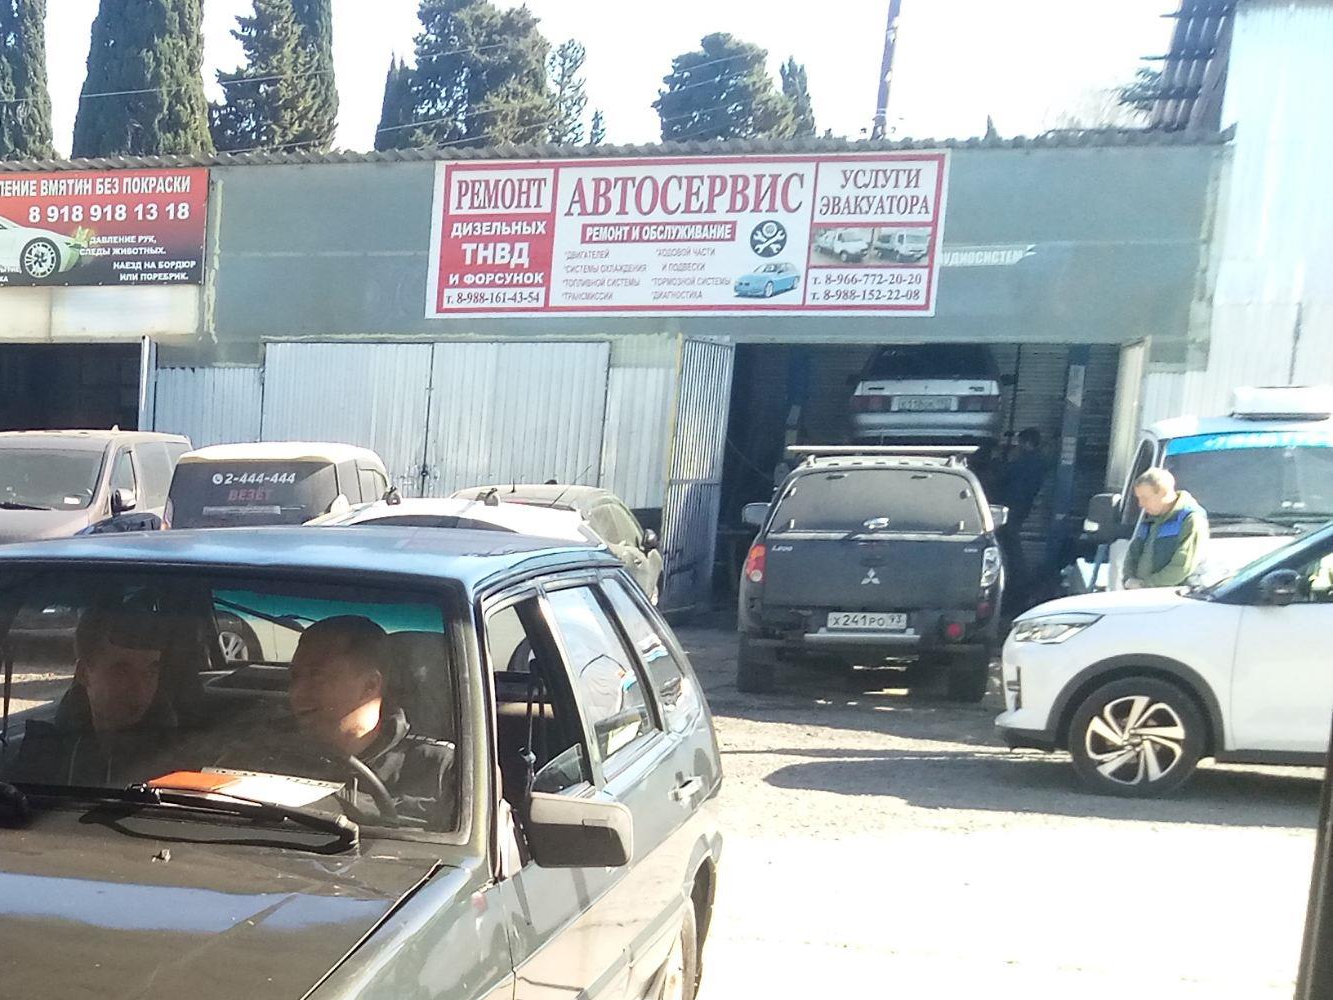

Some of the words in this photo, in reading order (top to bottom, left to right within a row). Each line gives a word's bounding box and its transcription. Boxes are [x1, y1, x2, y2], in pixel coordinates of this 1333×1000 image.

[840, 168, 922, 189] УСЛУГИ
[40, 178, 92, 196] ВМЯТИН
[95, 177, 120, 195] БЕЗ
[122, 175, 191, 194] ПОКРАСКИ
[455, 177, 547, 210] РЕМОНТ
[564, 172, 806, 217] АВТОСЕРВИС
[819, 194, 930, 216] ЭВАКУАТОРА
[28, 206, 41, 223] 8
[46, 205, 84, 222] 918
[89, 204, 127, 222] 918
[133, 203, 158, 221] 13
[165, 202, 190, 220] 18
[450, 220, 547, 238] ДИЗЕЛЬНЫХ
[585, 226, 629, 241] РЕМОНТ
[631, 225, 640, 240] И
[642, 224, 732, 240] ОБСЛУЖИВАНИЕ
[89, 235, 136, 245] ДАВЛЕНИЕ
[138, 235, 157, 245] РУК,
[79, 247, 111, 256] СЛЕДЫ
[112, 246, 166, 255] ЖИВОТНЫХ.
[461, 241, 530, 268] ТНВД
[693, 248, 715, 256] ЧАСТИ
[113, 261, 142, 270] НАЕЗД
[144, 261, 156, 269] НА
[158, 260, 196, 269] БОРДЮР
[120, 273, 138, 281] ИЛИ
[140, 272, 188, 281] ПОРЕБРИК.
[449, 273, 459, 285] И
[463, 272, 544, 284] ФОРСУНОК
[607, 277, 640, 287] СИСТЕМЫ
[697, 277, 731, 286] СИСТЕМЫ
[824, 273, 922, 285] 8-966-772-20-20
[456, 291, 540, 304] 8-988-161-43-54
[823, 289, 920, 301] 8-988-152-22-08
[224, 472, 296, 485] 2-444-444
[833, 614, 885, 627] Х241РО
[889, 614, 902, 624] 93
